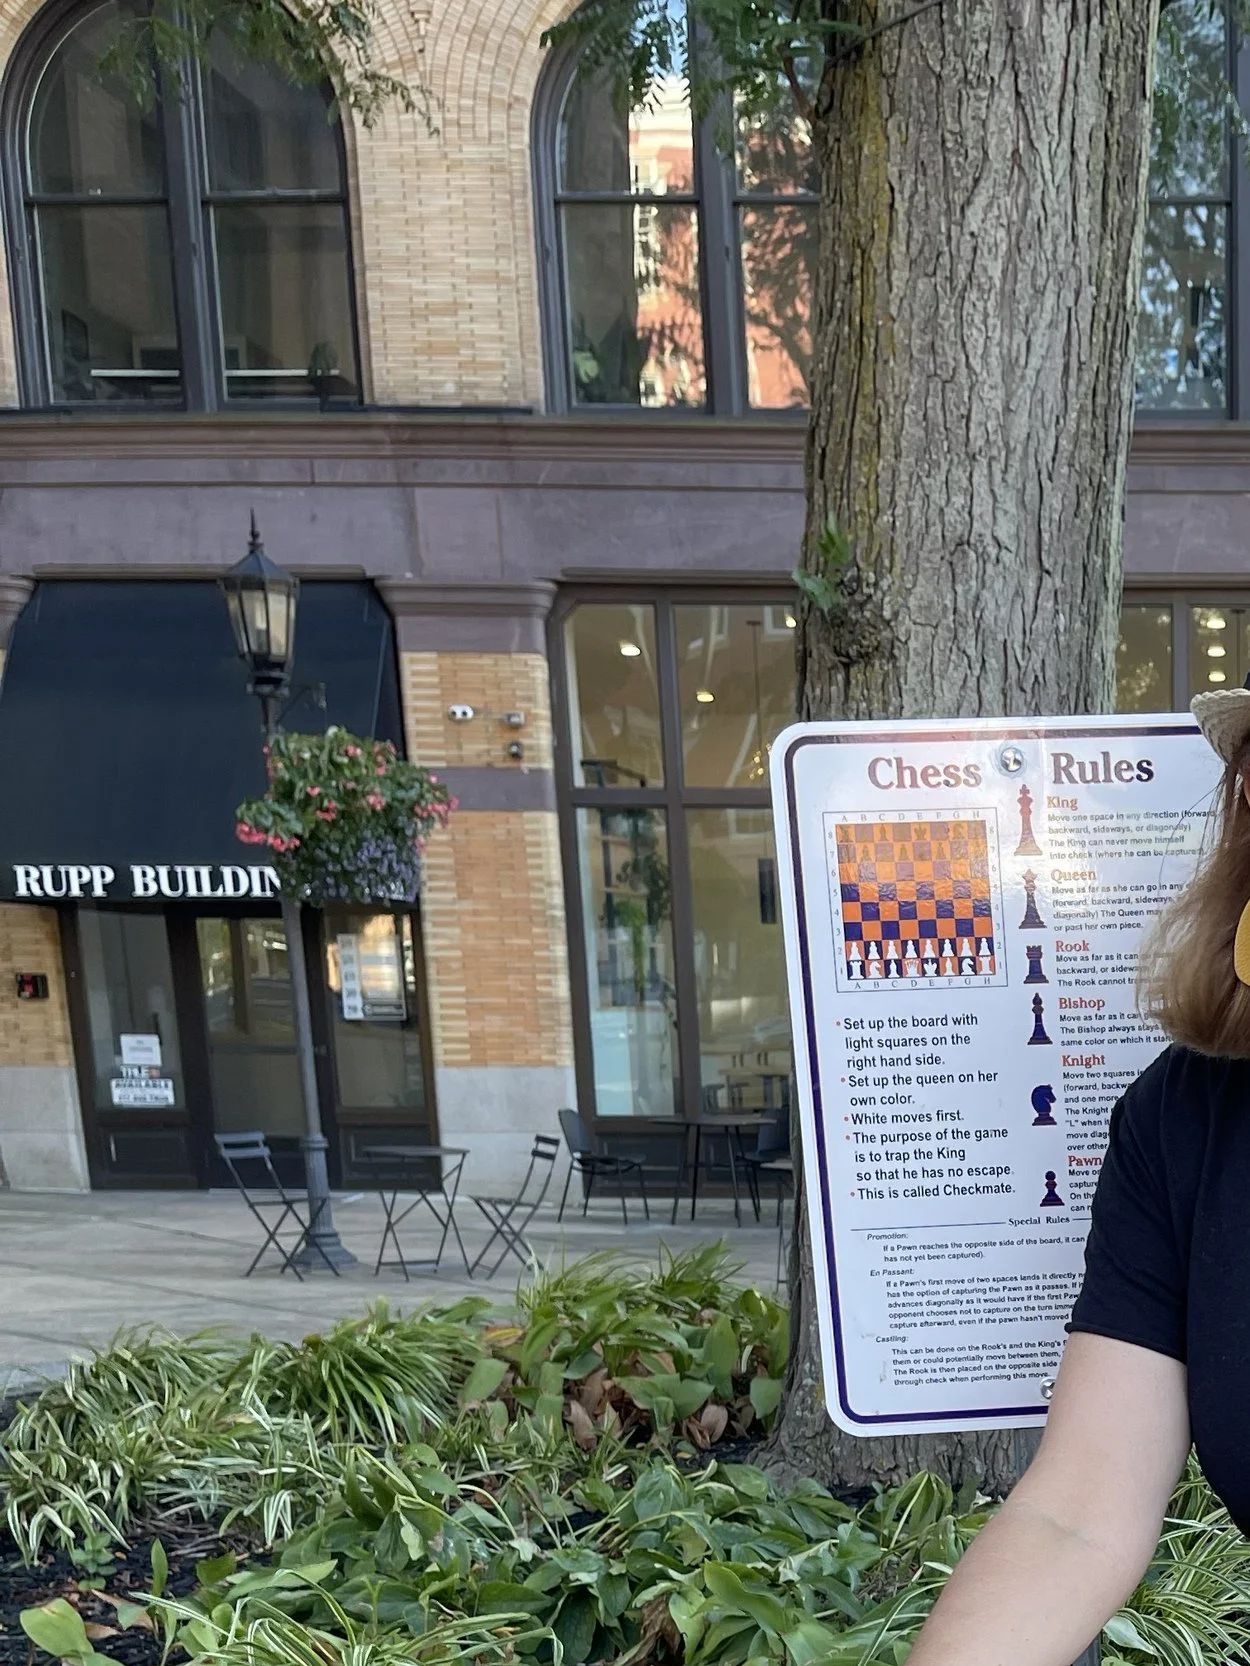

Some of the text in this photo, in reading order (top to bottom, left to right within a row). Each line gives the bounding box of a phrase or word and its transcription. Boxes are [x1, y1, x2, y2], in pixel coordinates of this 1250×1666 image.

[867, 751, 1155, 790] Chess Rules
[1046, 796, 1078, 811] King
[12, 865, 282, 898] RUPP BUILDIN
[1050, 869, 1097, 884] Queen
[1055, 940, 1090, 953] Rook
[1058, 997, 1105, 1011] Bishop
[843, 1013, 978, 1032] Set up the board with
[845, 1032, 970, 1051] light squares on the
[846, 1052, 945, 1071] right hand side.
[1062, 1054, 1106, 1069] Knight
[848, 1070, 998, 1089] Set up the queen on her
[850, 1092, 915, 1106] own color.
[851, 1109, 964, 1125] White moves first.
[853, 1127, 1008, 1146] The purpose of the game
[854, 1146, 966, 1164] is to trap the King
[1068, 1155, 1102, 1166] Pawn
[856, 1165, 1014, 1181] so that he has no escape.
[858, 1182, 1016, 1200] This is called Checkmate.
[1007, 1215, 1070, 1226] Special Rules
[866, 1232, 908, 1240] Promotion:
